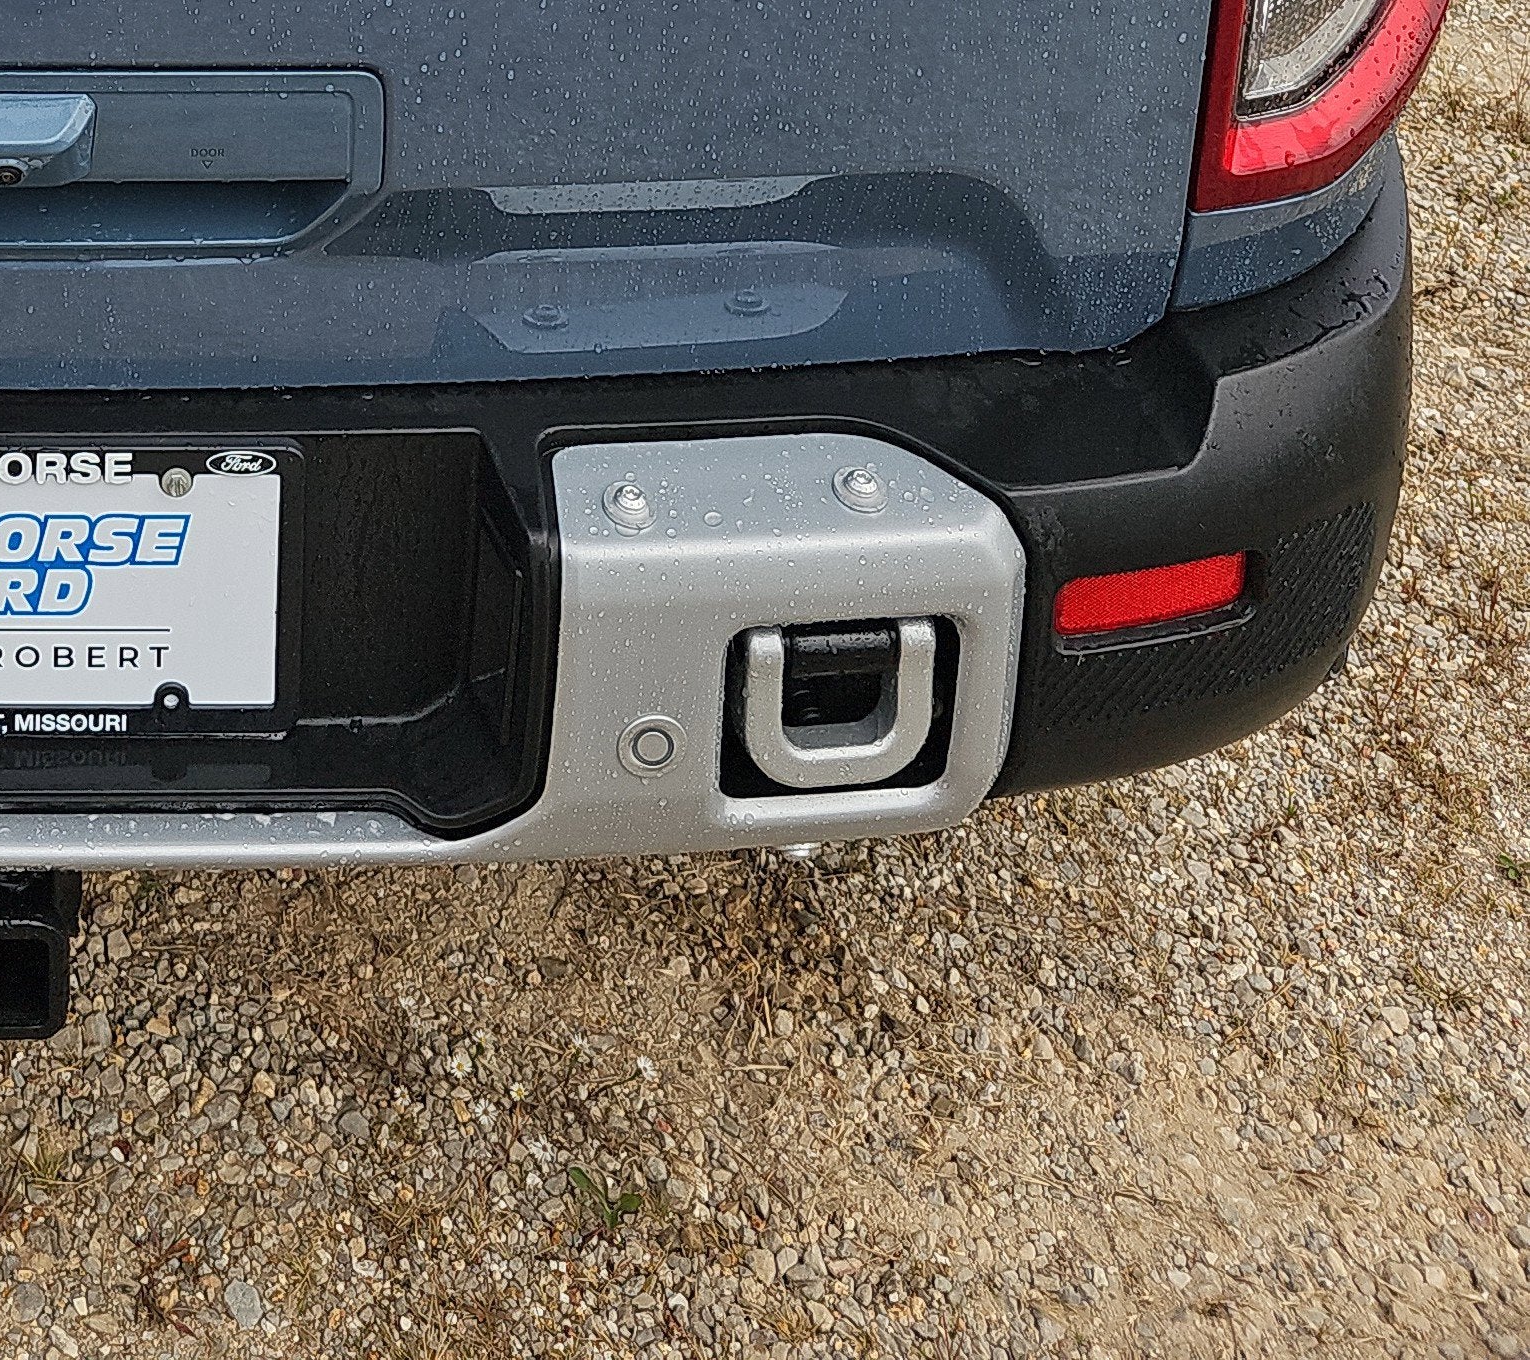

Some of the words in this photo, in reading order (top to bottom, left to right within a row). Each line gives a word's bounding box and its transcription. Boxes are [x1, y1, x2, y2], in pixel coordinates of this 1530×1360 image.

[190, 147, 225, 158] DOOR
[220, 454, 262, 472] Ford
[15, 714, 127, 732] MISSOURI
